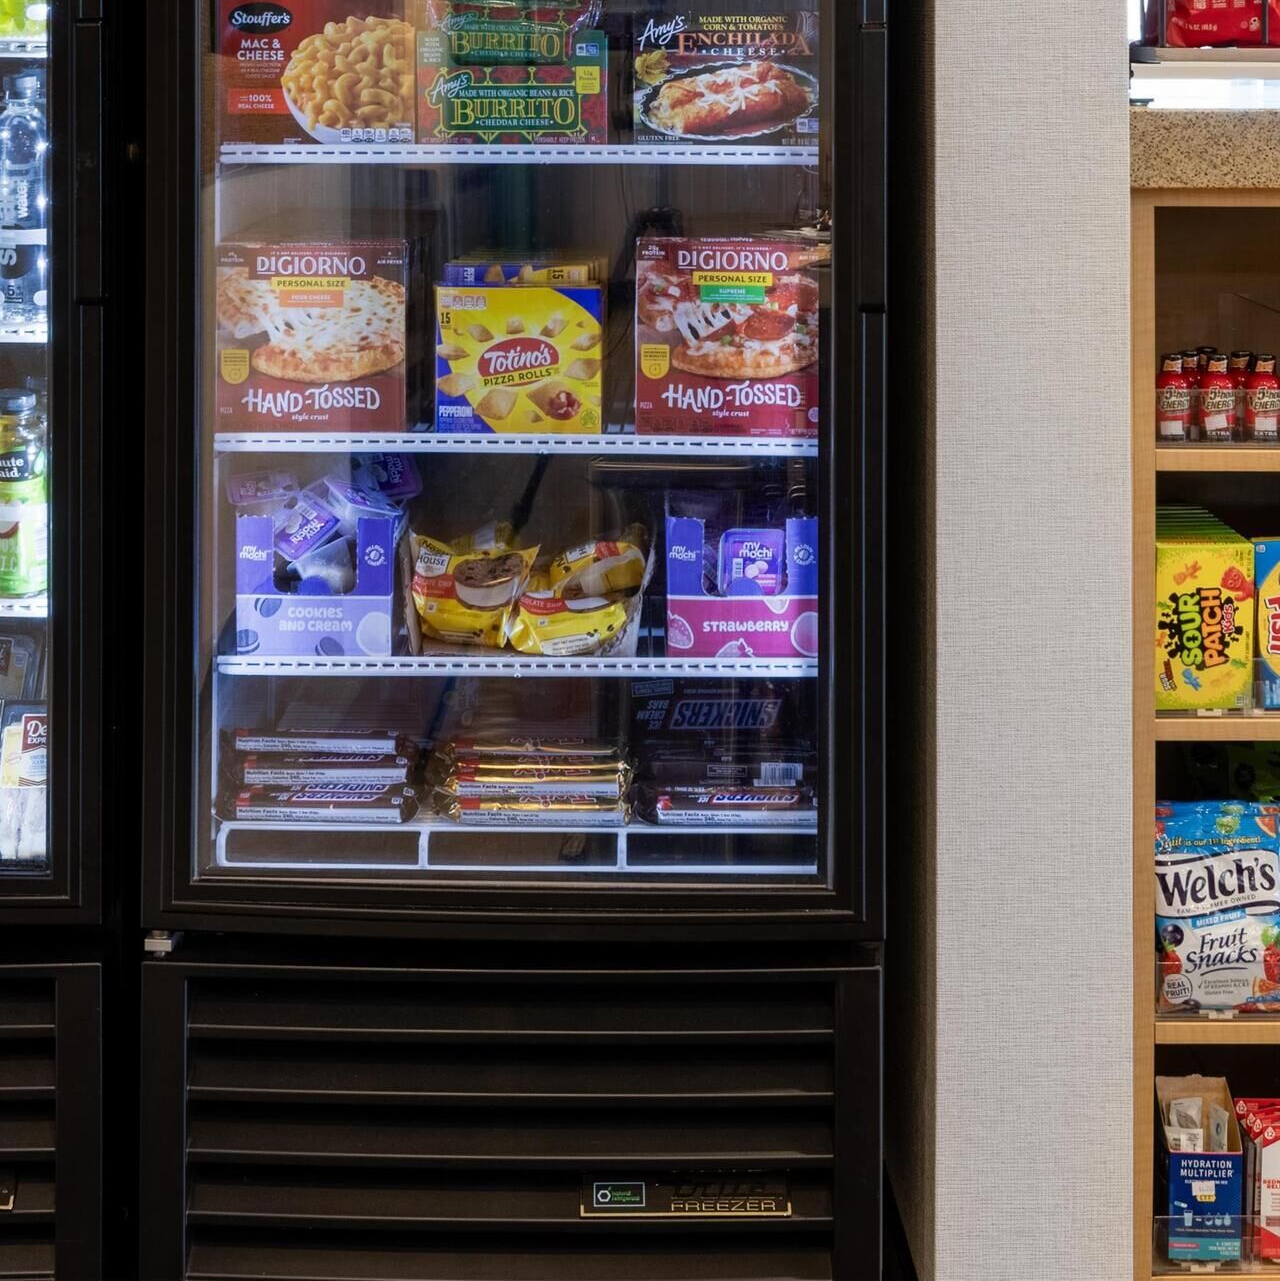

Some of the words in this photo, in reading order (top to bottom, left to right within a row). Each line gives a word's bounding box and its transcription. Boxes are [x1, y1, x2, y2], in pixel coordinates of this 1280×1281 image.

[232, 10, 290, 27] Stouffer's
[699, 15, 723, 23] MADE
[724, 15, 746, 23] WITH
[747, 15, 788, 24] ORGANIC
[703, 23, 726, 31] CORN
[728, 23, 736, 31] &
[738, 23, 783, 31] TOMATOES
[241, 38, 263, 48] MAC
[272, 38, 281, 48] &
[451, 31, 560, 57] BURRITO
[639, 15, 687, 50] Amy's
[676, 30, 813, 57] ENCHILADA
[237, 49, 284, 62] CHEESE
[431, 72, 469, 102] Amy's
[450, 97, 575, 126] BURRITO
[256, 255, 366, 276] DIGIORNO
[276, 279, 324, 288] PERSONAL
[326, 279, 346, 288] SIZE
[483, 343, 554, 373] Totino's
[483, 372, 516, 387] PIZZA
[517, 367, 552, 381] ROLLS
[242, 384, 381, 416] HAND-TOSSED
[661, 380, 801, 412] HAND-TOSSED
[438, 405, 473, 417] PEPPERONI
[738, 547, 773, 559] mochi
[1199, 587, 1222, 668] PATCH
[1223, 603, 1234, 633] Kids
[1180, 593, 1202, 667] SOUR
[1155, 857, 1277, 907] Welch's
[1195, 915, 1218, 926] MIXED
[1219, 911, 1242, 921] FRUIT
[1199, 927, 1248, 955] Fruit
[1185, 946, 1258, 974] Snacks
[1180, 1168, 1234, 1178] MULTIPLIER
[1181, 1159, 1233, 1169] HYDRATION
[671, 1199, 776, 1211] FREEZER
